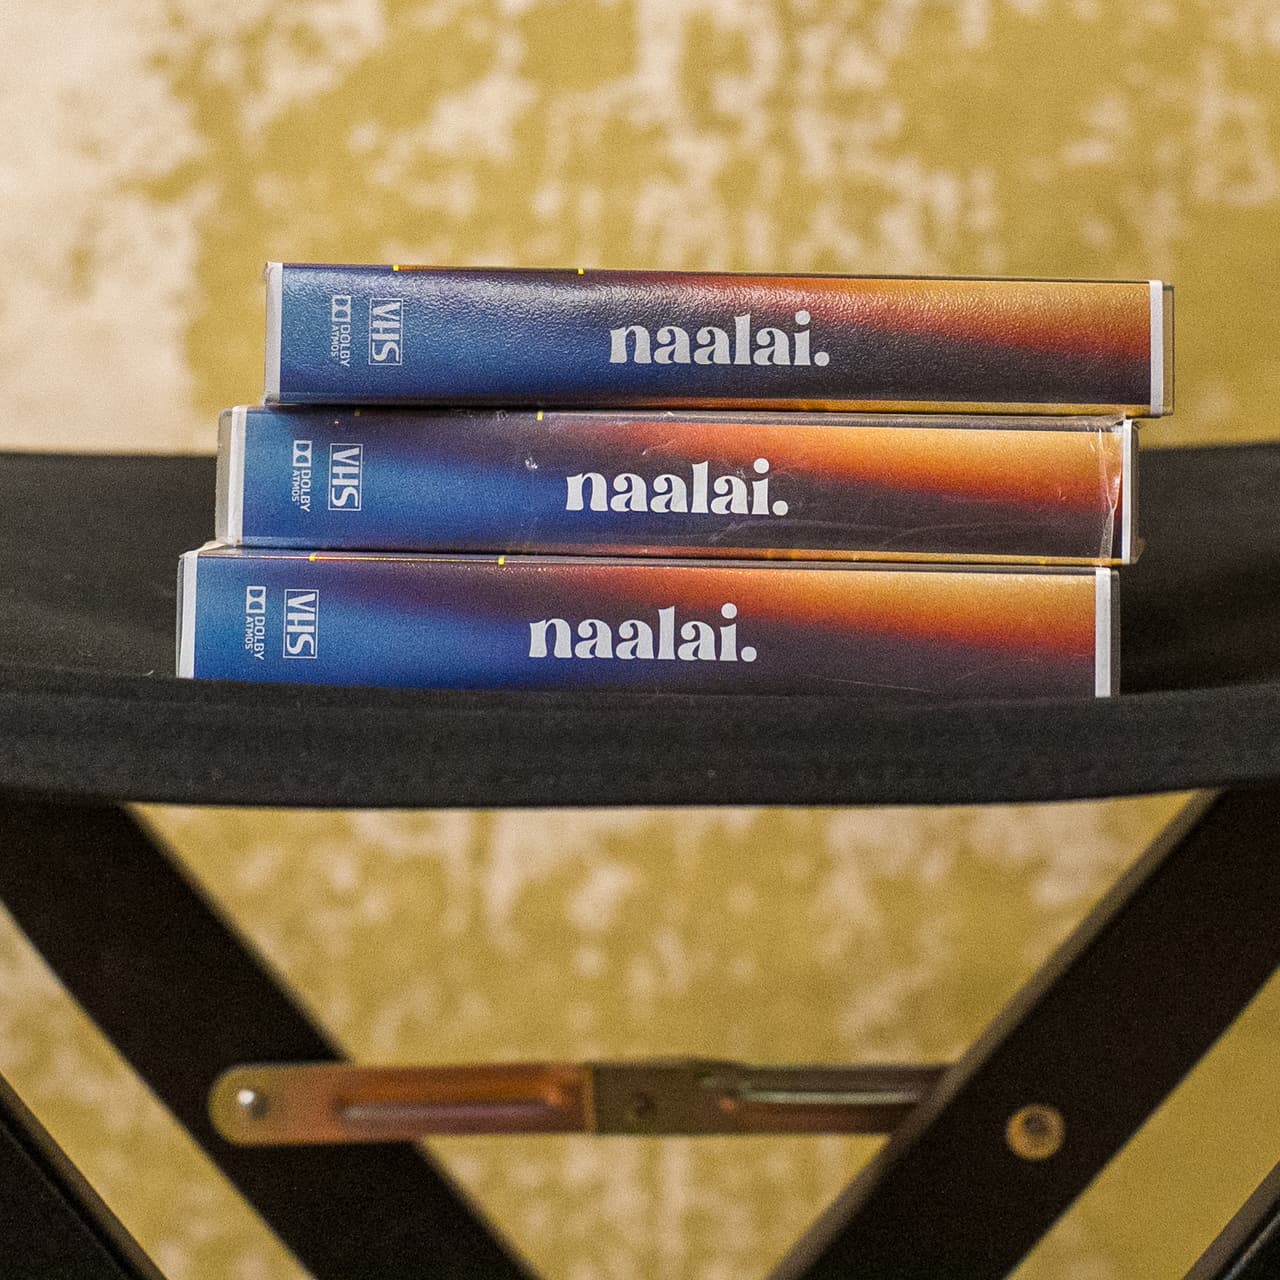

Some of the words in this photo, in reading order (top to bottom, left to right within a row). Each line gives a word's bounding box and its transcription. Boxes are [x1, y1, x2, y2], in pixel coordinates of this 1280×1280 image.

[340, 324, 351, 368] DOLBY
[371, 302, 401, 362] VHS
[608, 310, 830, 368] naalai.
[300, 469, 312, 512] DOLBY
[331, 447, 360, 508] VHS
[565, 458, 789, 517] naalai.
[254, 616, 266, 661] DOLBY
[286, 593, 316, 655] VHS
[528, 602, 758, 663] naalai.
